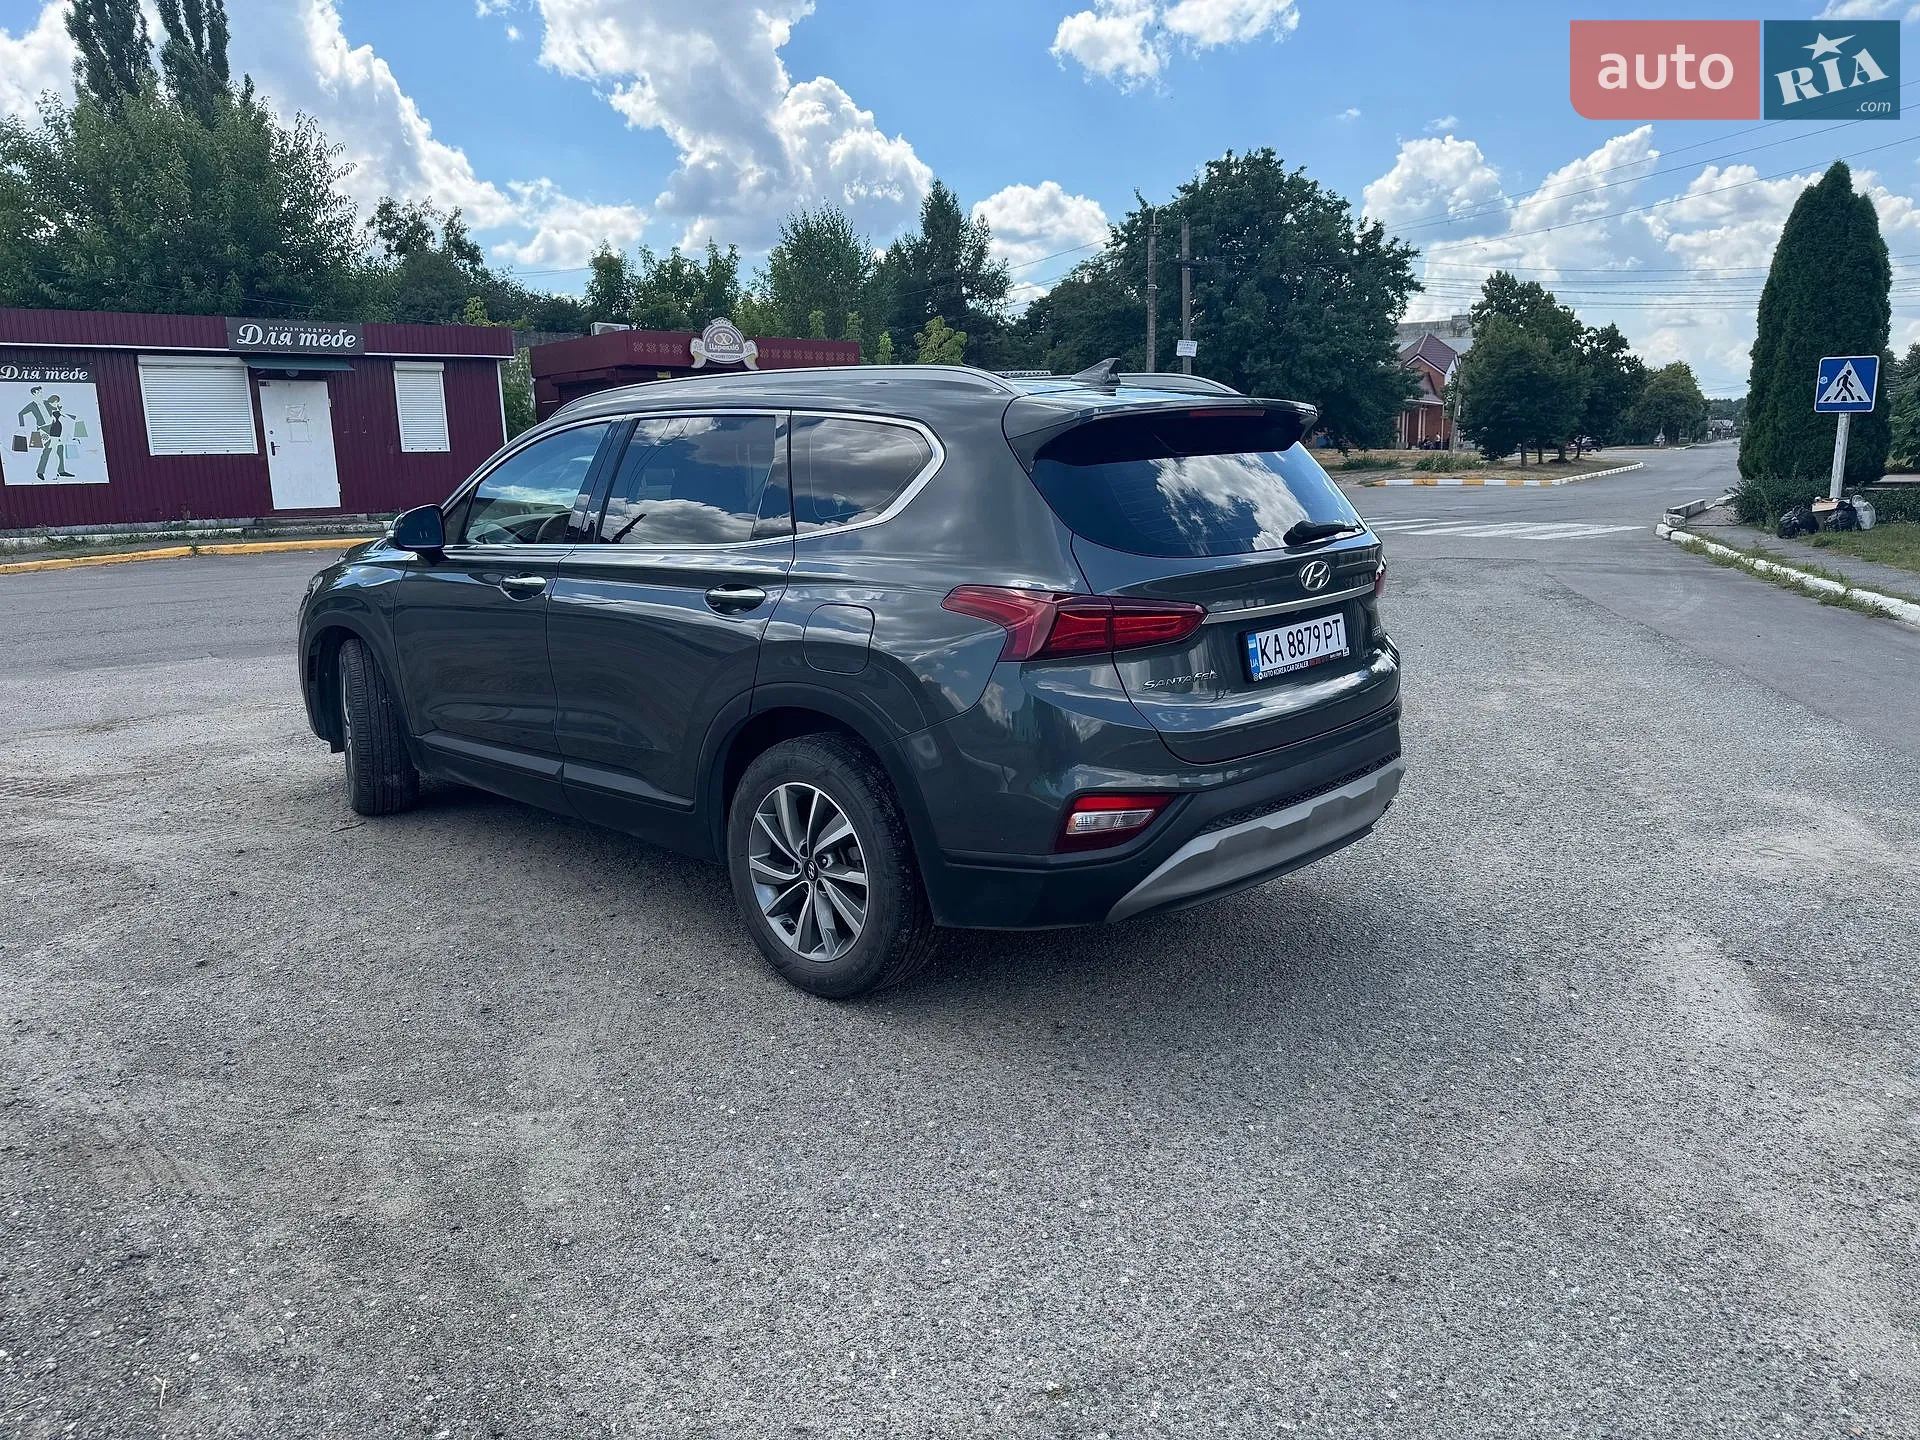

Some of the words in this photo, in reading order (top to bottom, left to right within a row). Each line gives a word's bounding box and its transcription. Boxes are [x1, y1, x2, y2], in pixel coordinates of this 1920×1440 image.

[236, 323, 293, 345] Для
[298, 329, 356, 348] тебе
[0, 365, 41, 379] Для
[44, 367, 88, 380] тебе
[1259, 633, 1284, 666] KA
[1287, 624, 1321, 659] 8879
[1323, 618, 1340, 649] PT
[1250, 658, 1259, 667] UA
[1273, 666, 1287, 676] KOREA
[1287, 664, 1295, 673] CAR
[1294, 660, 1310, 670] DEALER
[1142, 675, 1192, 691] SANTA
